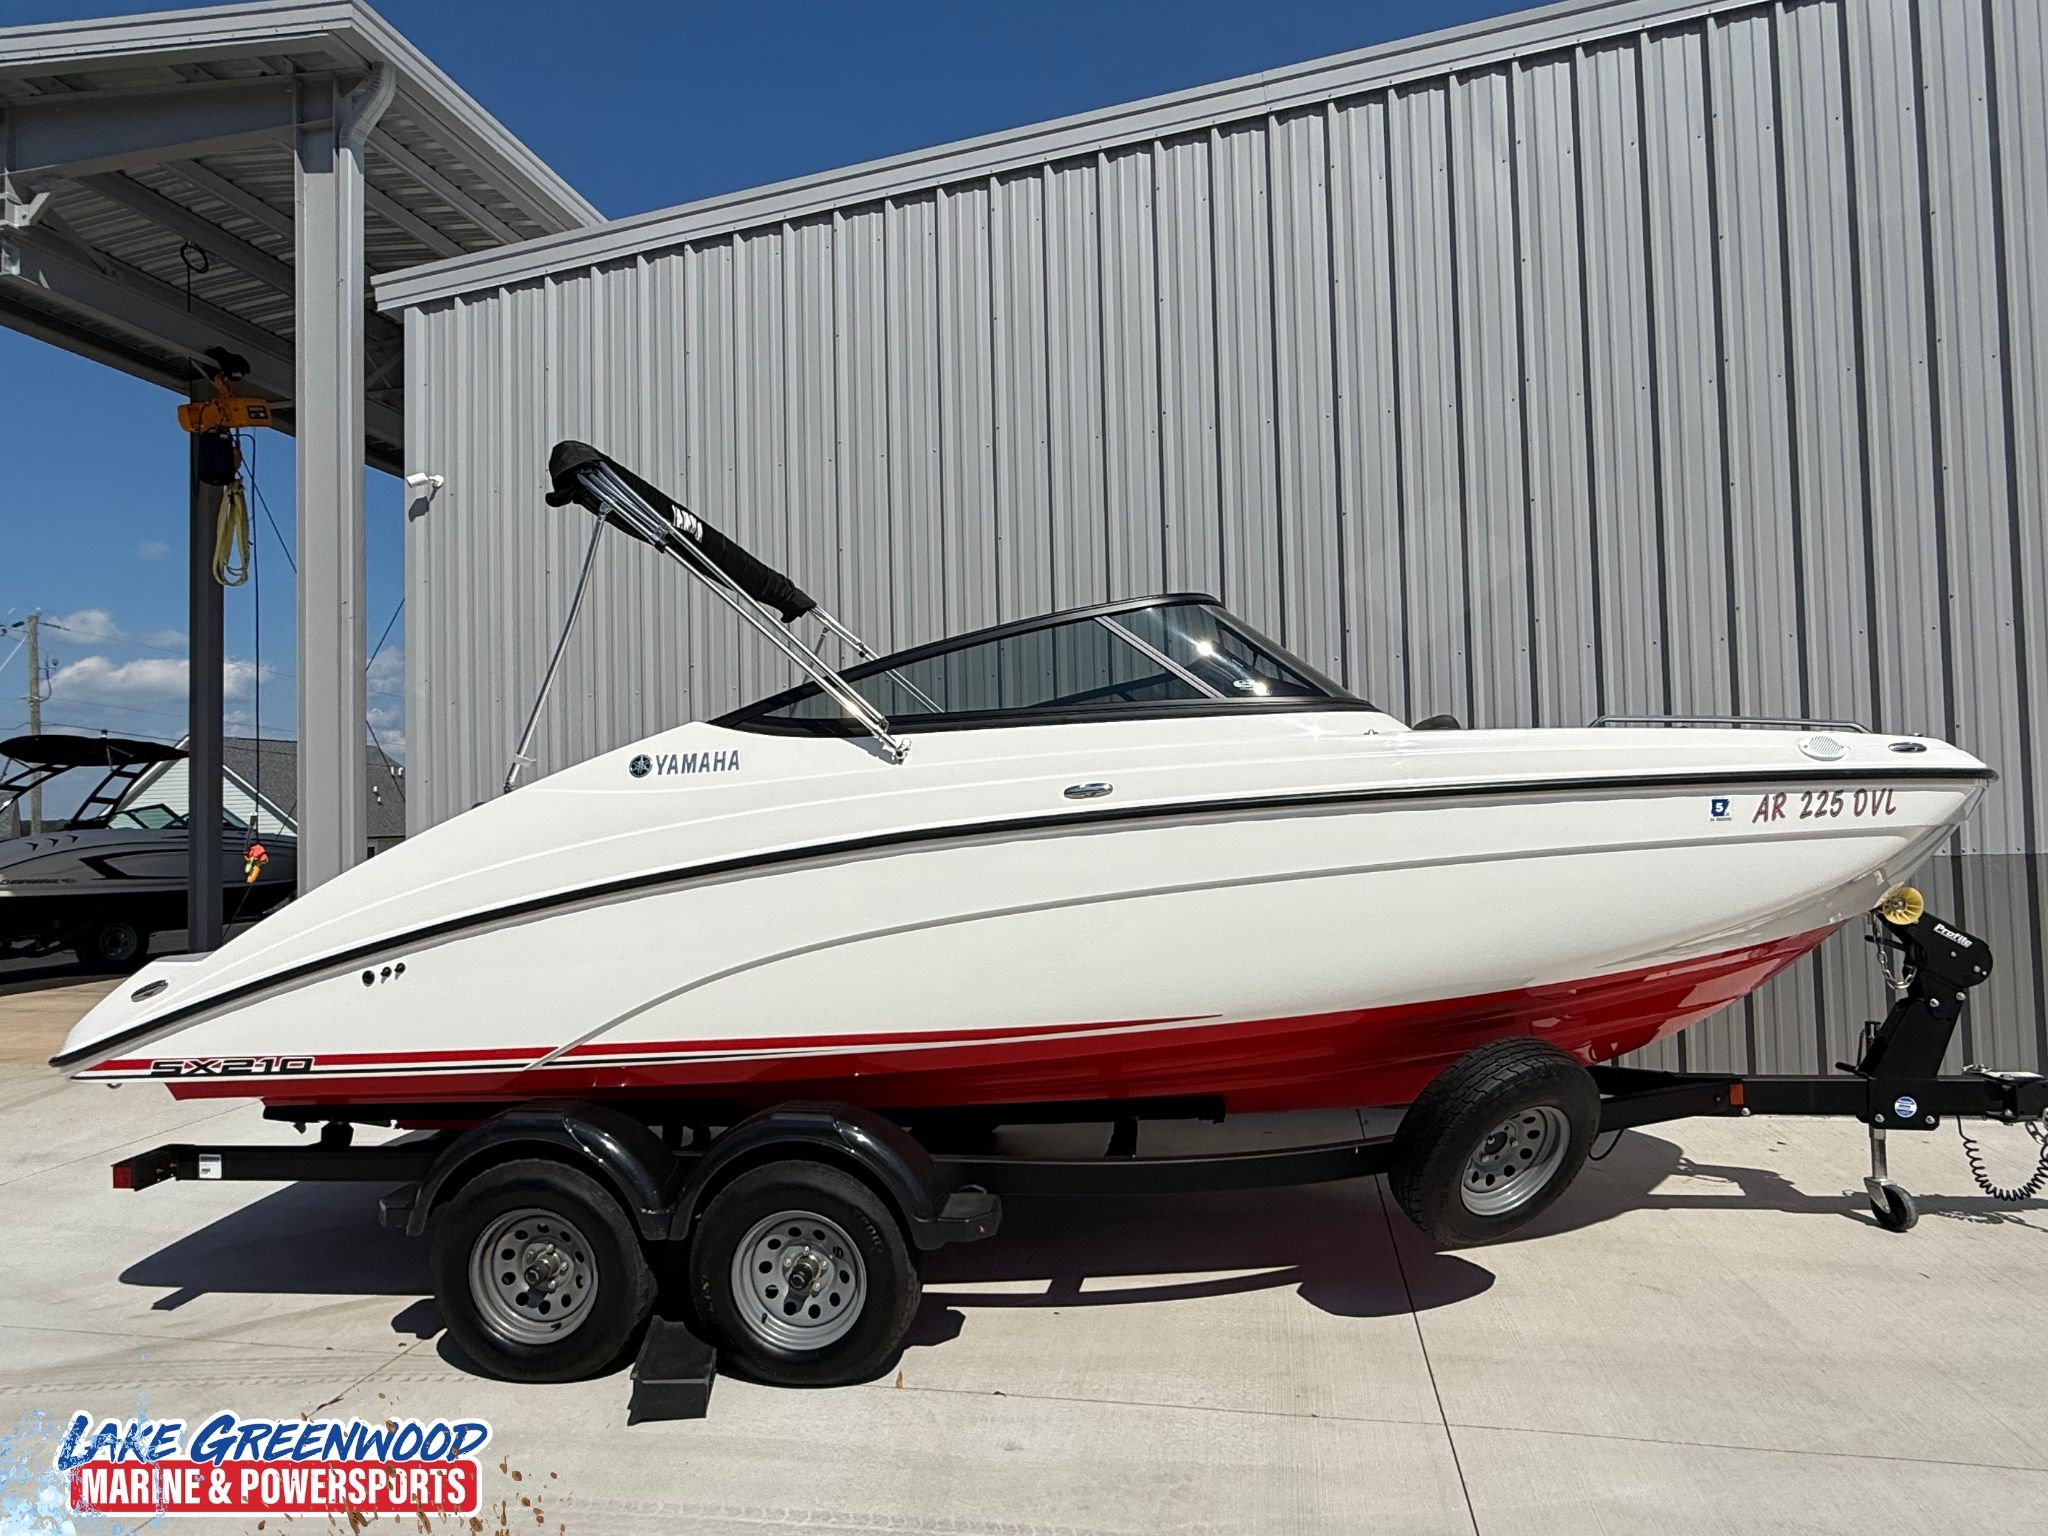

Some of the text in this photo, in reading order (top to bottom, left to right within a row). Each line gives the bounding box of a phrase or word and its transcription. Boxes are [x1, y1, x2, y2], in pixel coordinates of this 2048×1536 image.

[656, 750, 740, 775] YAMAHA
[1752, 792, 1788, 824] AR
[1799, 789, 1845, 820] 225
[1933, 922, 1973, 949] Profile
[151, 1057, 315, 1076] SX210
